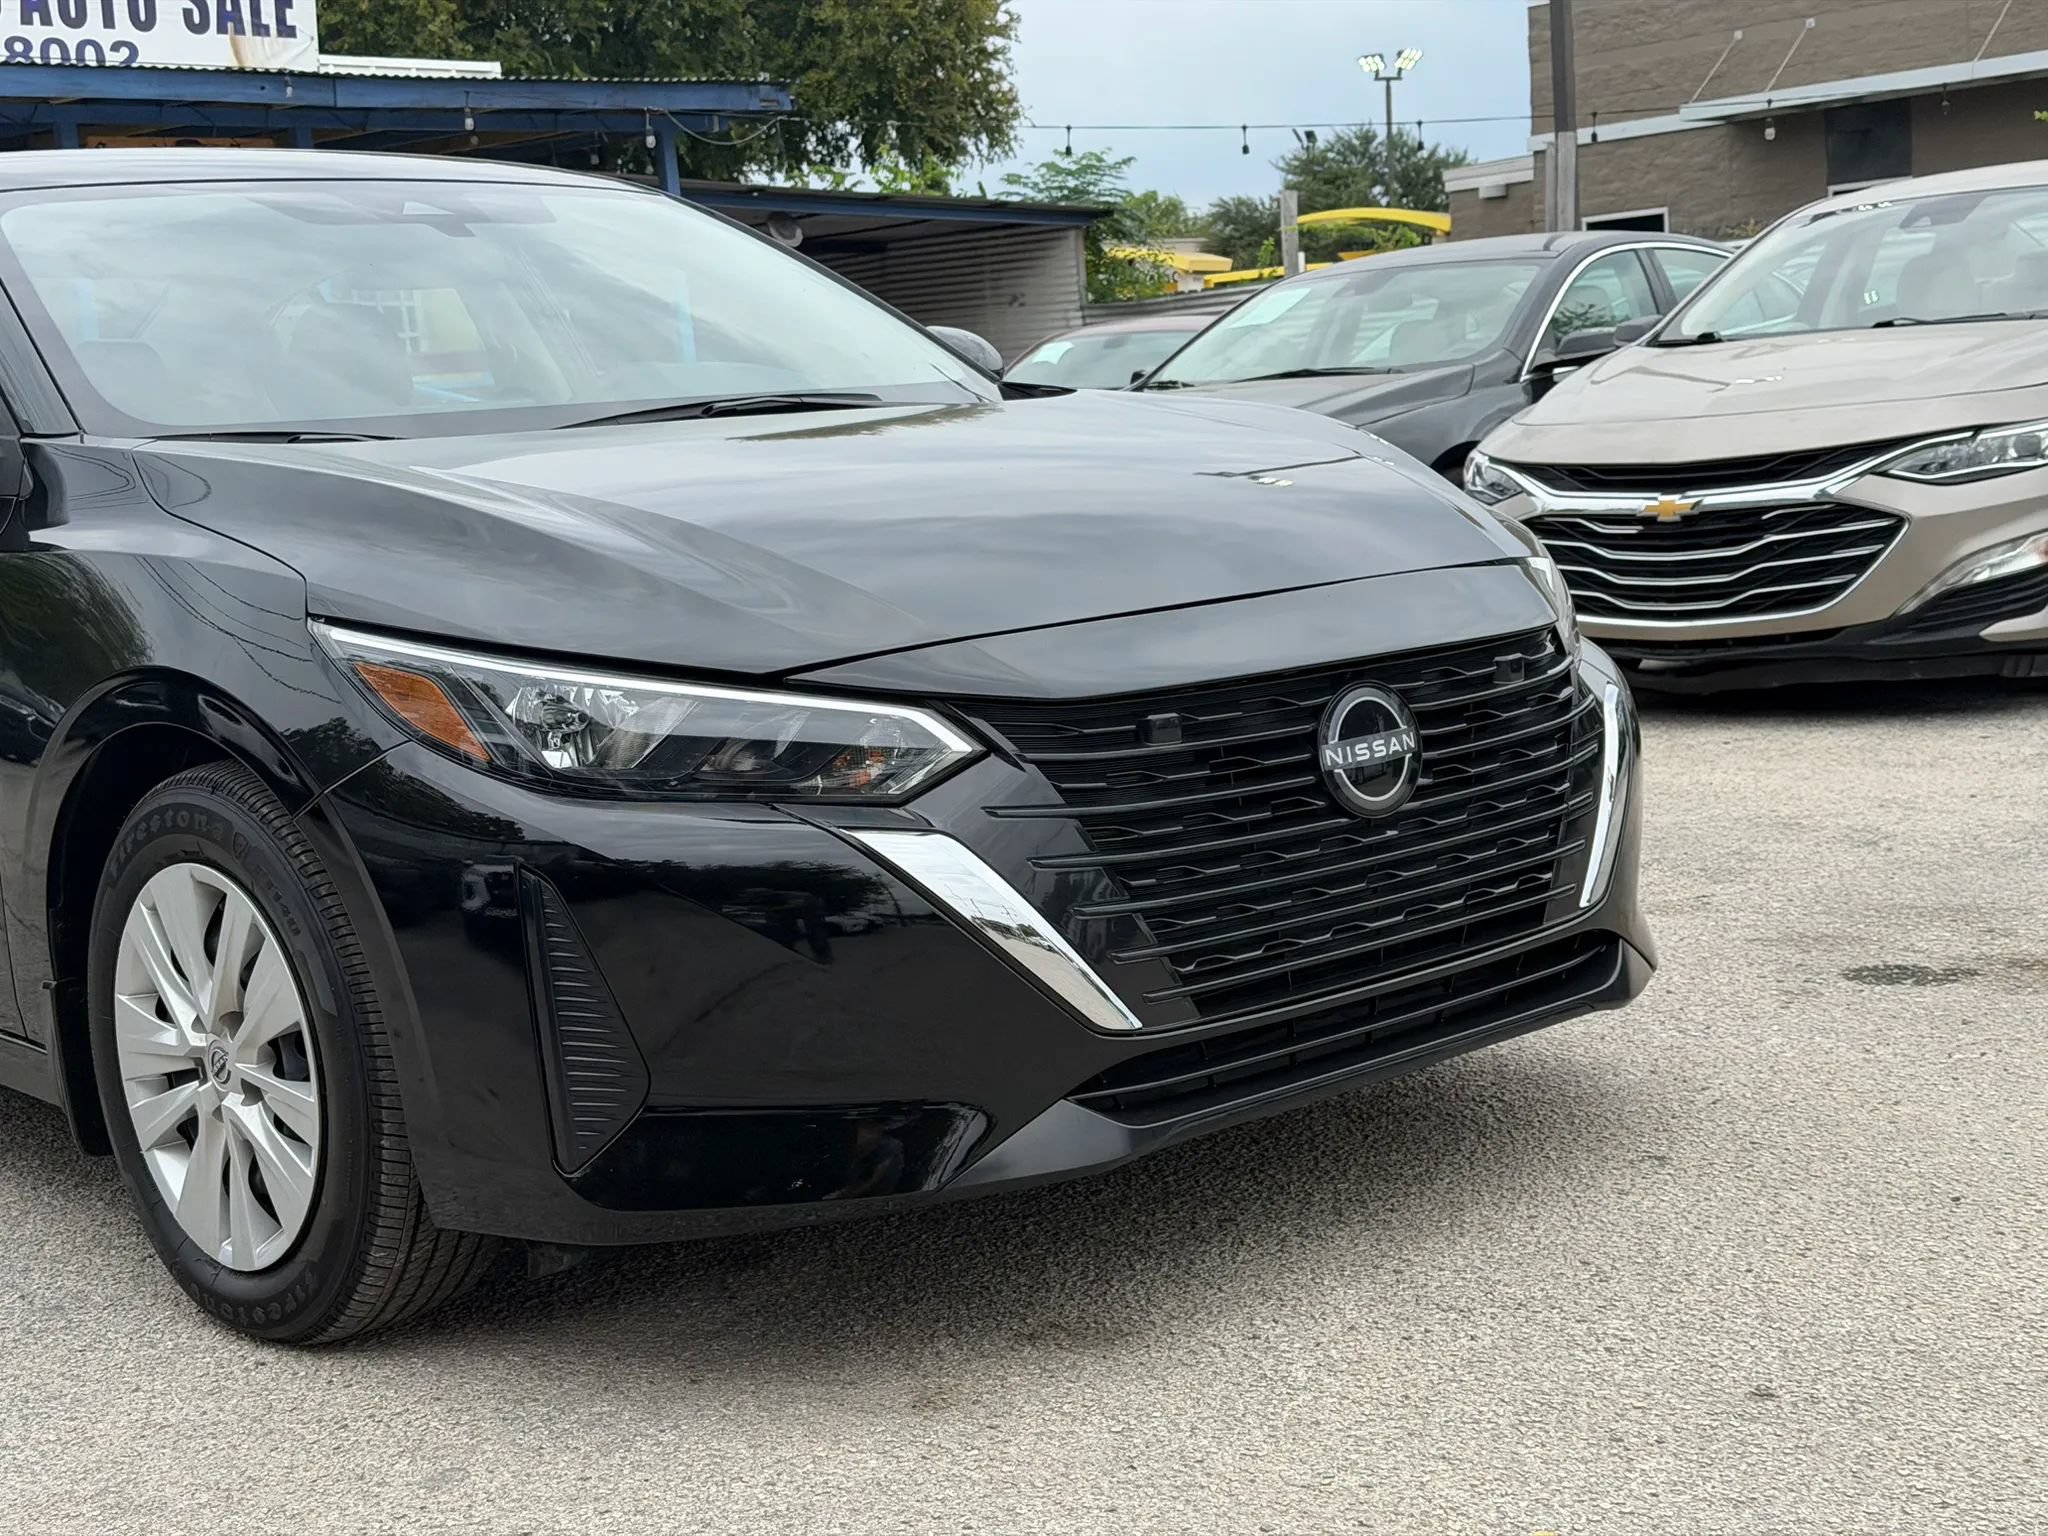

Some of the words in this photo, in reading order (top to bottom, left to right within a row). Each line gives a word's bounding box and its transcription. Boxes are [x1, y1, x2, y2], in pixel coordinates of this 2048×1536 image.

[182, 0, 298, 38] SALE
[4, 35, 139, 66] 8002
[1325, 732, 1415, 766] NISSAN
